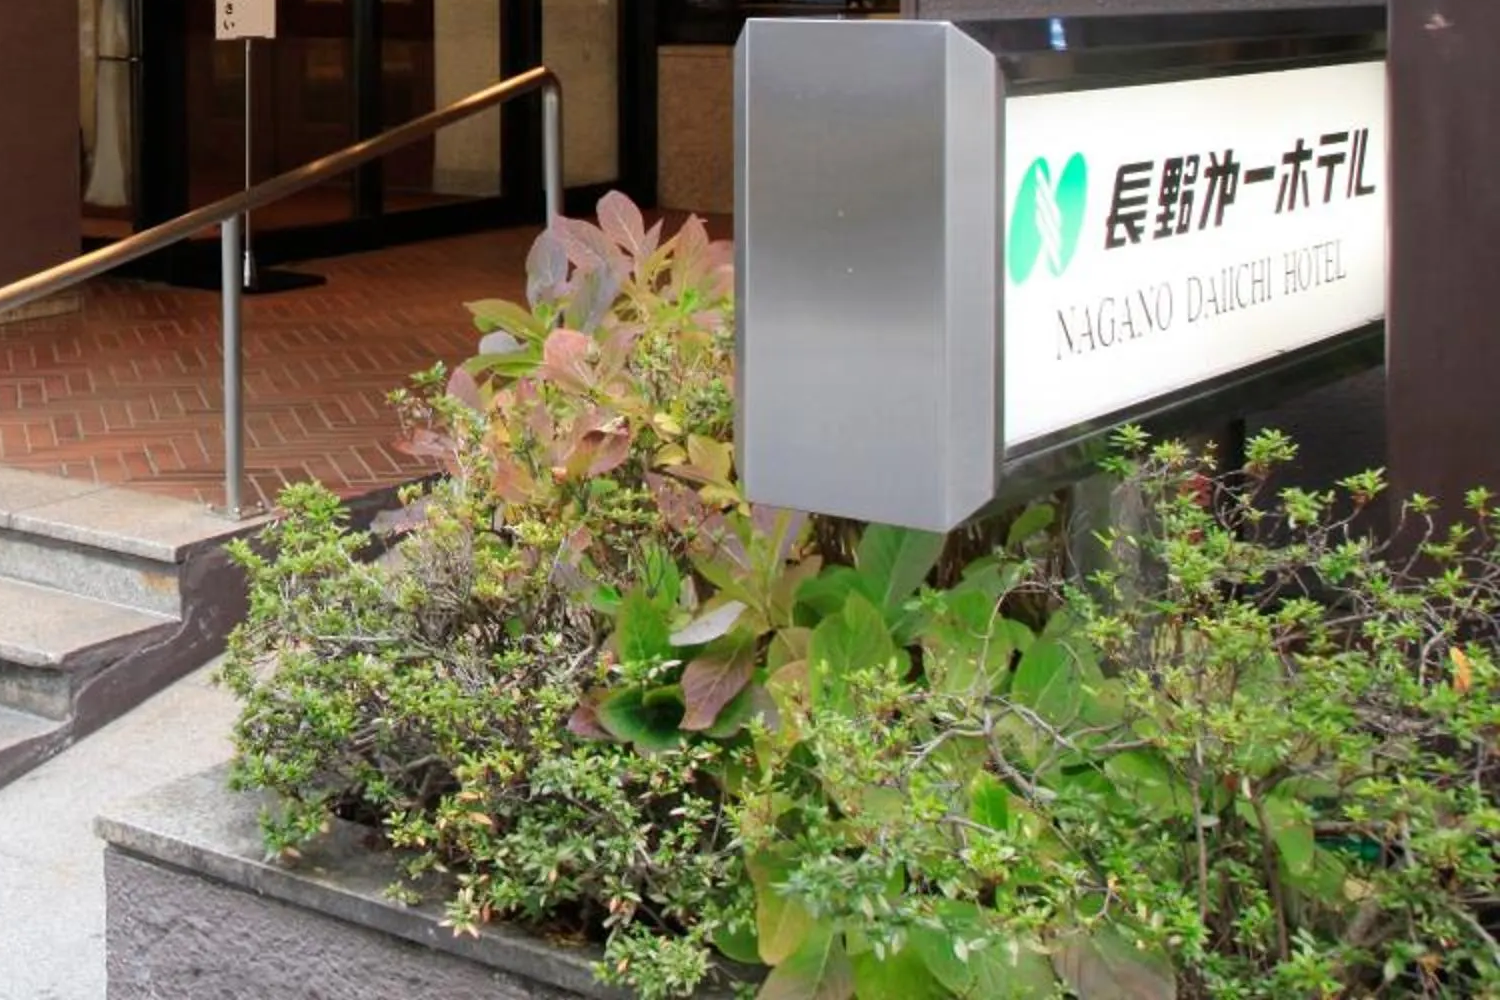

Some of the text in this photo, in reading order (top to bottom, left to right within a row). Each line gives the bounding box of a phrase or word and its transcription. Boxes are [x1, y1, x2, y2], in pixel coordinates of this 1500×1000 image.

[1056, 238, 1347, 360] NAGANO DAIICHI HOTEL
